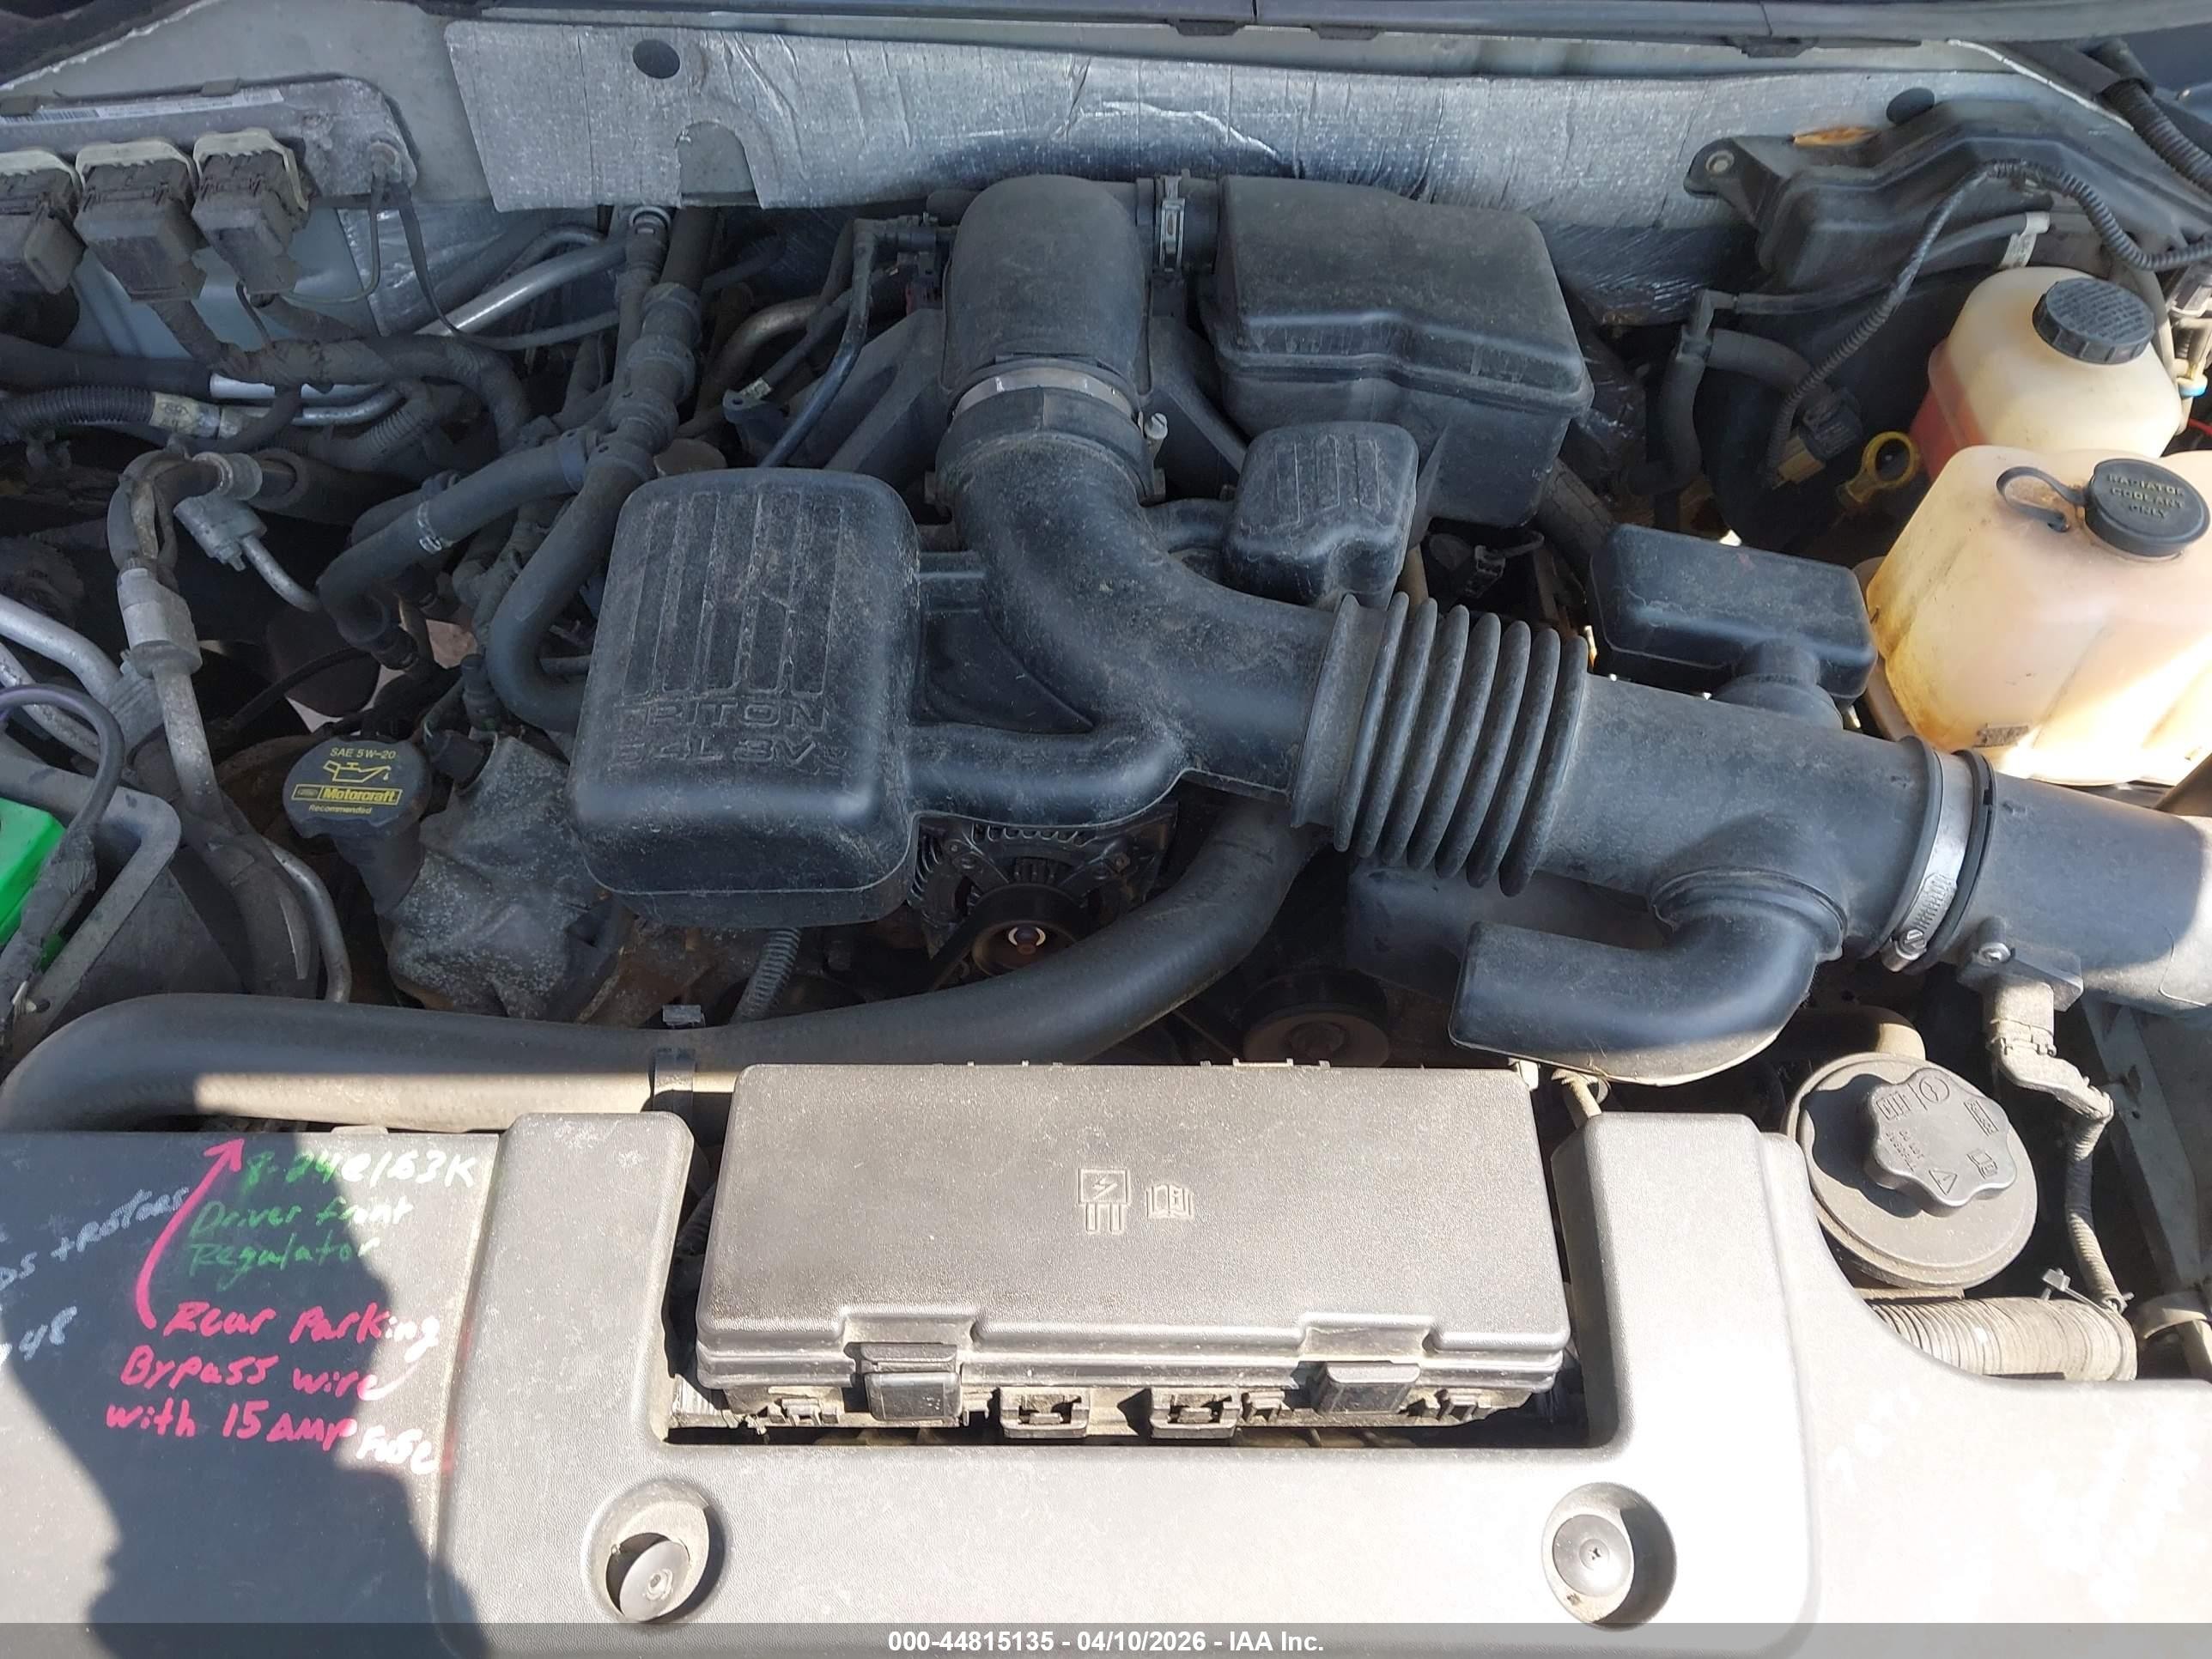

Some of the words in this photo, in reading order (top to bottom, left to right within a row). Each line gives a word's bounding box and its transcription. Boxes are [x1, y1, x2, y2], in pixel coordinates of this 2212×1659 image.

[2109, 474, 2185, 496] RADIATOR
[2111, 488, 2185, 508] COOLANT
[2129, 505, 2169, 520] ONLY
[330, 747, 354, 758] SAE
[356, 749, 396, 759] 5W-20
[324, 788, 396, 802] Motorcraft
[309, 804, 372, 814] Recommended
[187, 1200, 301, 1238] Driver
[163, 1300, 276, 1336] Rear
[105, 1397, 197, 1437] with
[222, 1399, 270, 1440] 15
